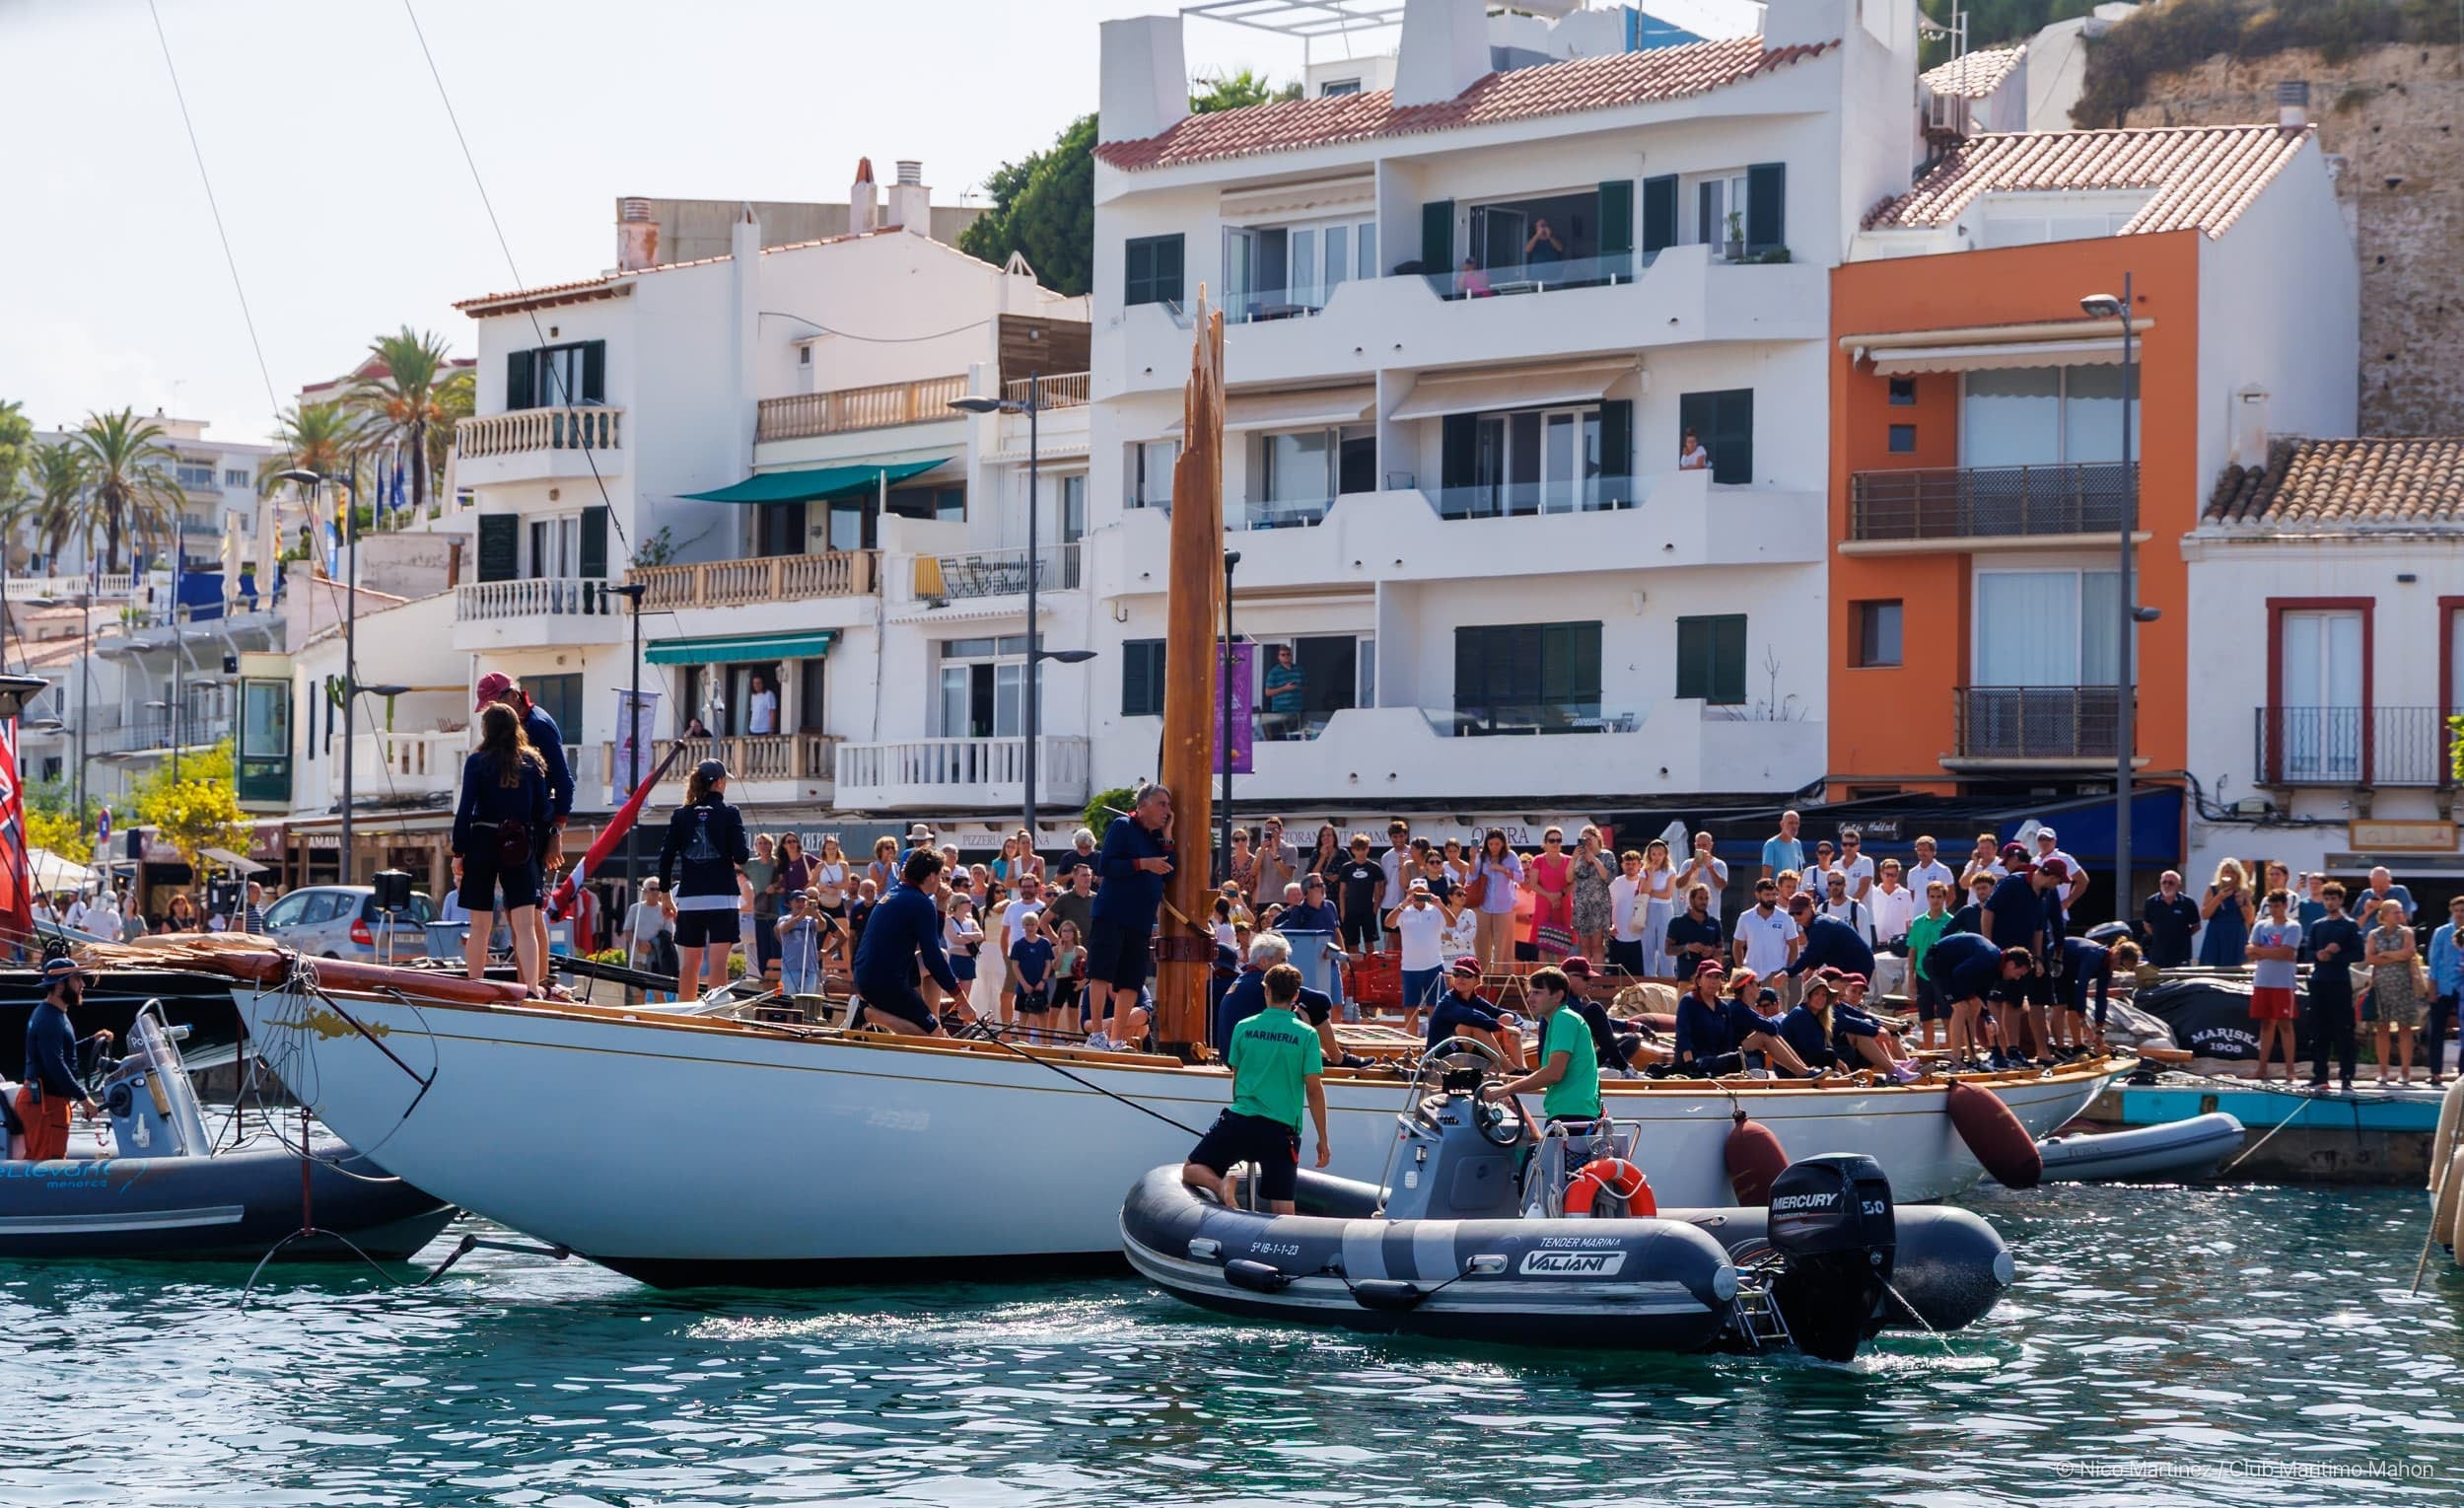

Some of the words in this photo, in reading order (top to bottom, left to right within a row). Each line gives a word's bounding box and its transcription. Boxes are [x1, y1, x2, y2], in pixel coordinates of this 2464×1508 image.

[309, 835, 341, 848] AMAIA
[1471, 826, 1529, 844] ORA
[1244, 1030, 1300, 1045] MARINERIA
[2210, 1041, 2243, 1053] 1908
[46, 1179, 108, 1189] menorca
[1772, 1192, 1839, 1211] MERCURY
[1862, 1200, 1885, 1215] 50
[1540, 1237, 1580, 1248] TENDER
[1580, 1238, 1621, 1248] MARINA
[1527, 1253, 1620, 1272] VALIANT
